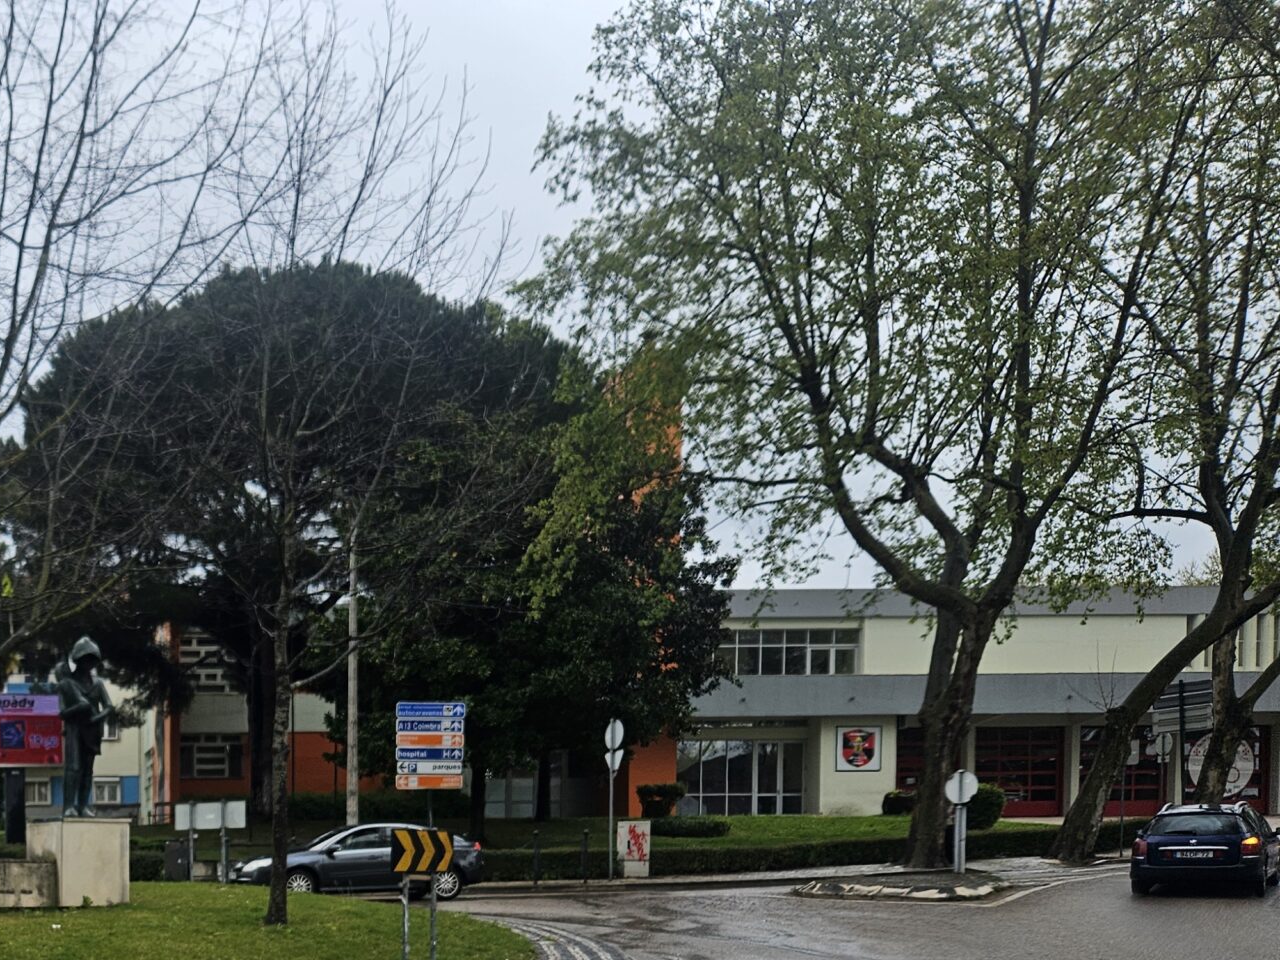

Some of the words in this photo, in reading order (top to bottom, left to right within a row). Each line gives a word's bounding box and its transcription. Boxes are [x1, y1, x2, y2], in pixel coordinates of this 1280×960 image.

[398, 722, 411, 730] A13
[412, 721, 442, 730] Coimbra
[398, 750, 427, 759] hospital
[432, 763, 461, 771] parques
